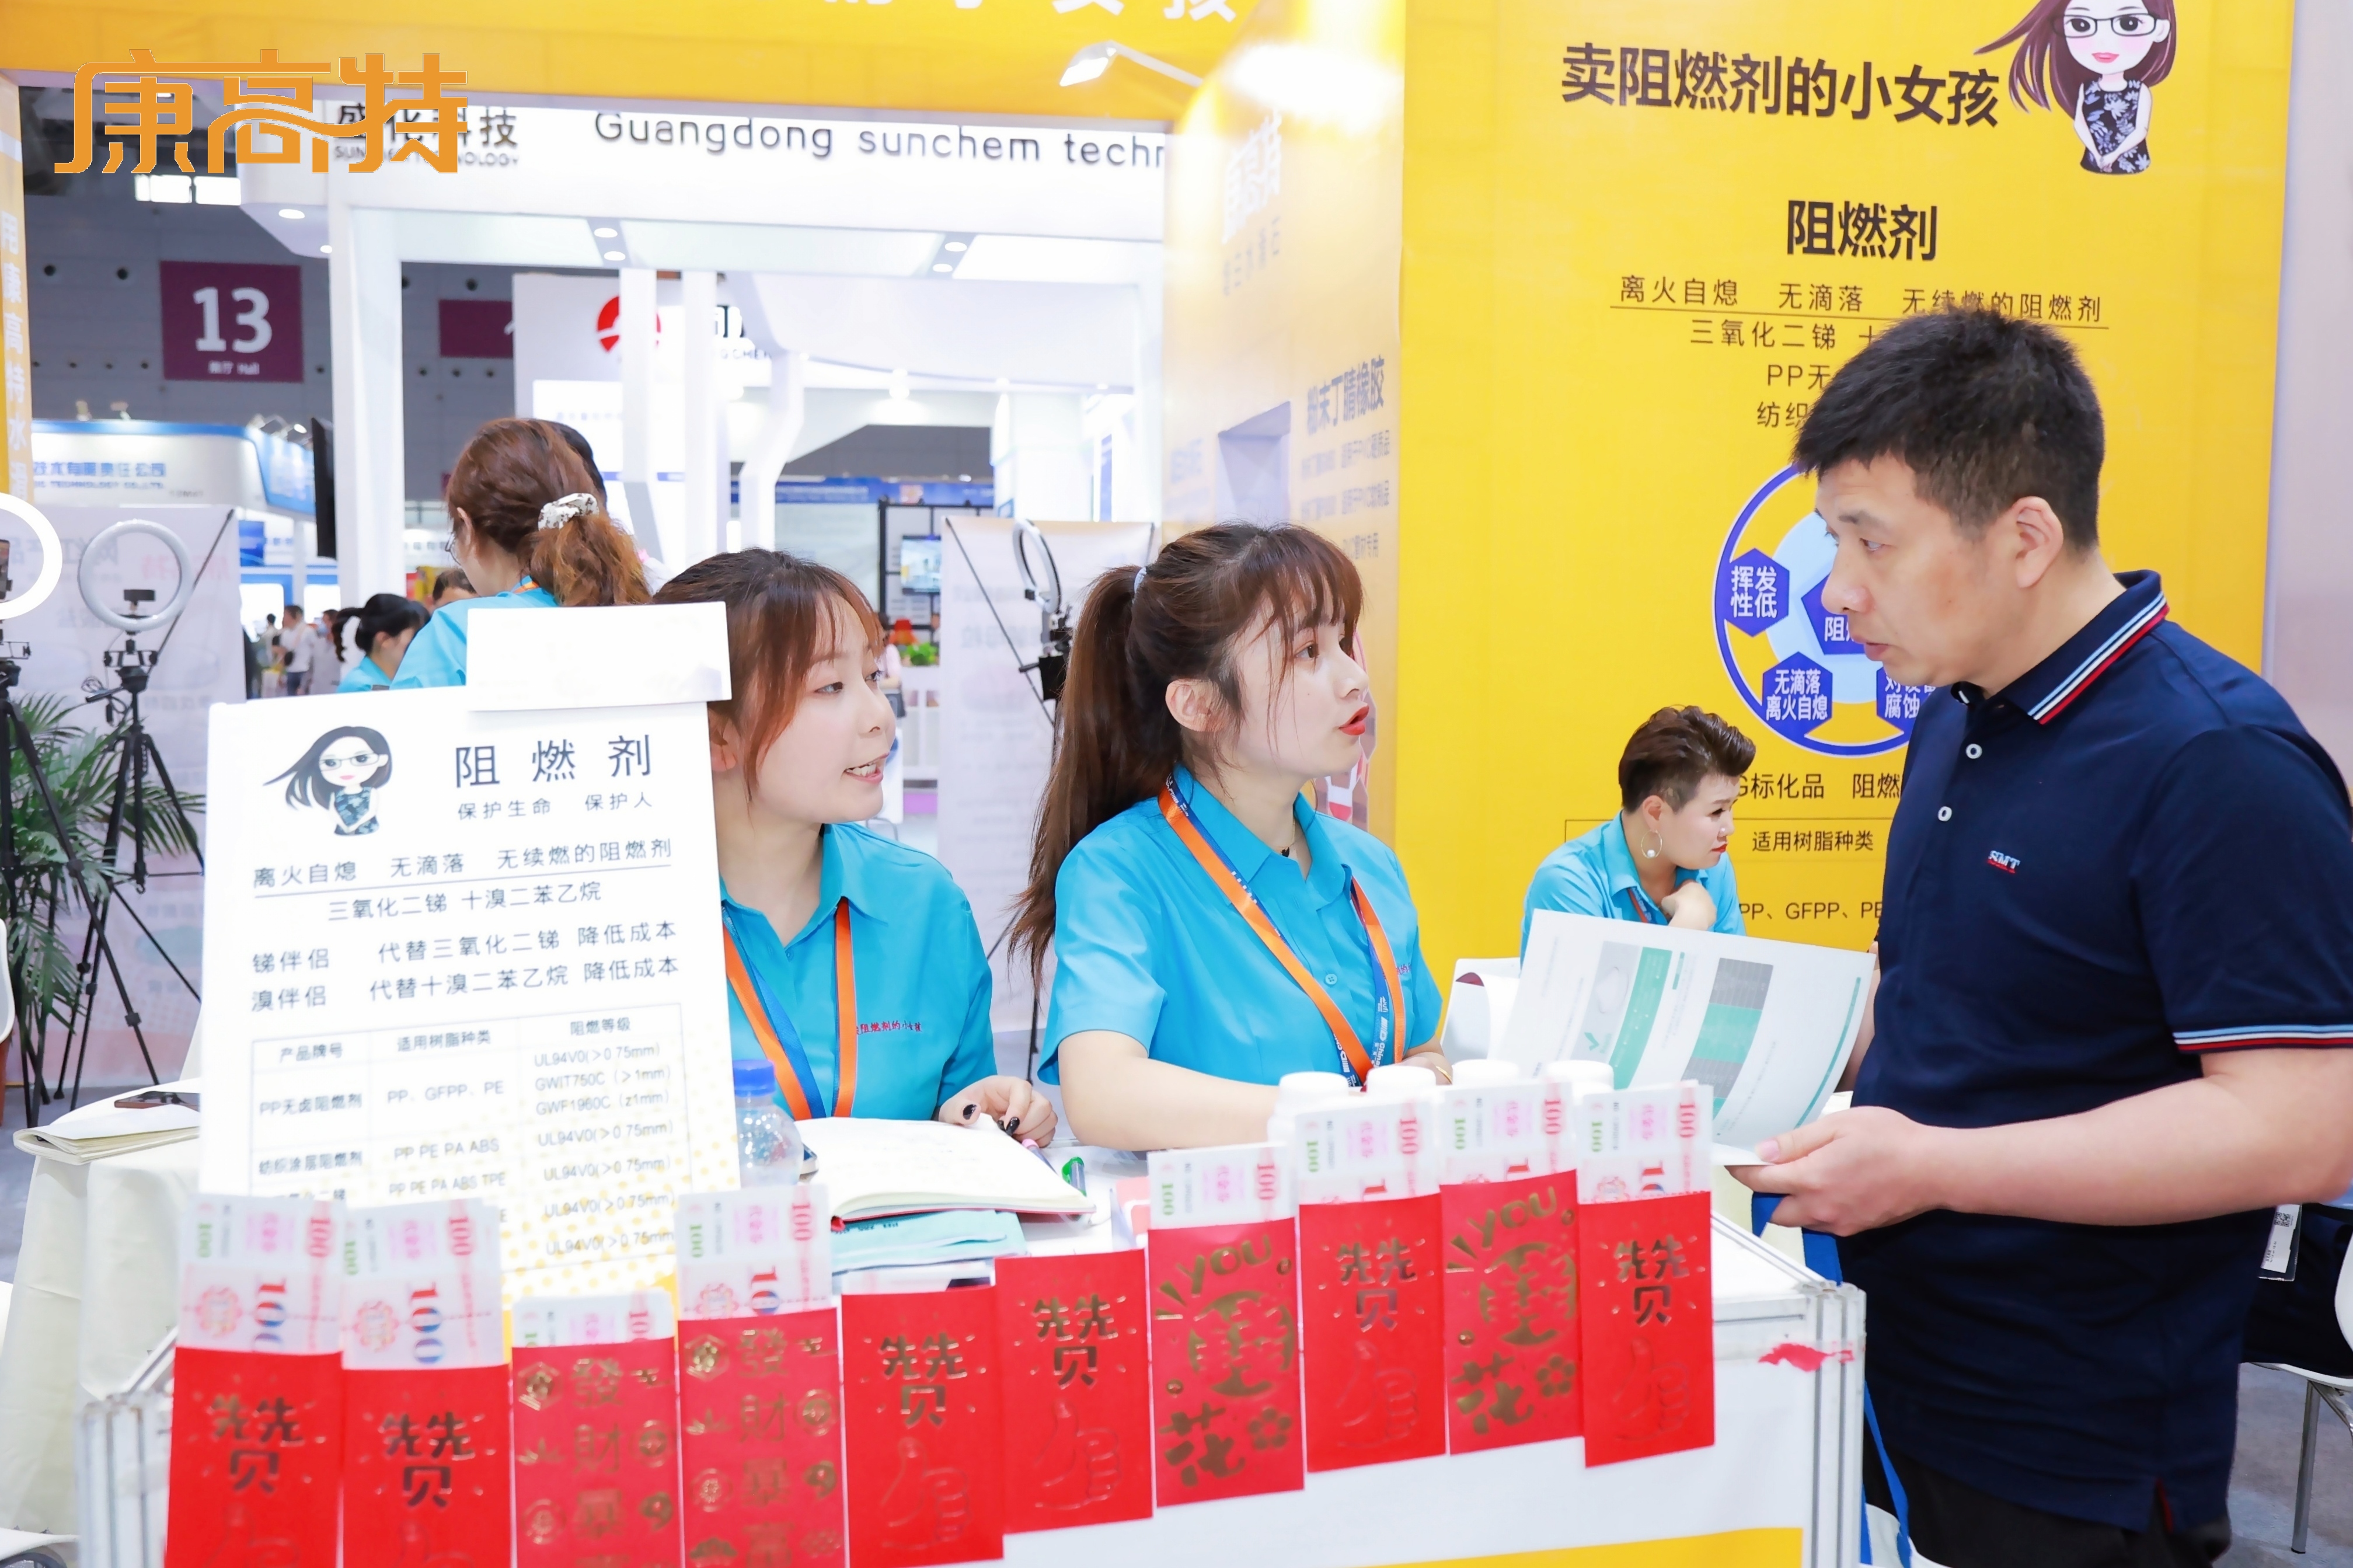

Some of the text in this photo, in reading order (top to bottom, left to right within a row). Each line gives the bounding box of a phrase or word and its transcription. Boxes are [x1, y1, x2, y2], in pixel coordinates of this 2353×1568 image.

[1562, 42, 2000, 128] 卖阻燃剂的小女孩
[596, 111, 833, 158] Guangdong
[858, 125, 1040, 163] sunchem
[1786, 200, 1938, 262] 阻燃剂
[1620, 275, 1739, 306] 离火自熄
[1779, 283, 1863, 312] 无滴落
[193, 287, 272, 353] 13
[1690, 319, 1837, 350] 三氧化二锑
[1730, 565, 1777, 592] 挥发
[1730, 591, 1777, 619] 性低
[1775, 668, 1821, 695] 无滴落
[1766, 694, 1828, 721] 离火自熄
[456, 734, 653, 788] 阻燃剂
[458, 791, 653, 821] 保护生命 保护人
[253, 837, 673, 890] 离火自熄 无滴落 无续燃的阻燃剂
[1752, 830, 1874, 852] 适用树脂种类
[327, 880, 603, 922] 三氧化二锑 十溴二苯乙烷
[252, 920, 678, 975] 锑伴侣 代替三氧化二锑 降低成本
[251, 956, 680, 1013] 溴伴侣 代替十溴二苯乙烷 降低成本
[280, 1017, 632, 1063] 产品牌号 适用树脂种类 阻燃等级
[1398, 1117, 1420, 1155] 100
[1545, 1098, 1562, 1135] 100
[1678, 1101, 1696, 1139] 100
[394, 1138, 500, 1161] PP PE PA ABS
[431, 1177, 448, 1192] PA
[452, 1175, 478, 1191] ABS
[1256, 1162, 1278, 1202] 100
[792, 1201, 814, 1242] 100
[1336, 1236, 1418, 1334] 赞
[1613, 1234, 1691, 1328] 赞
[1030, 1293, 1119, 1389] 赞
[877, 1332, 969, 1428] 赞
[1452, 1350, 1534, 1437] 花
[210, 1395, 305, 1493] 赞
[381, 1411, 476, 1509] 赞
[1159, 1402, 1246, 1489] 花
